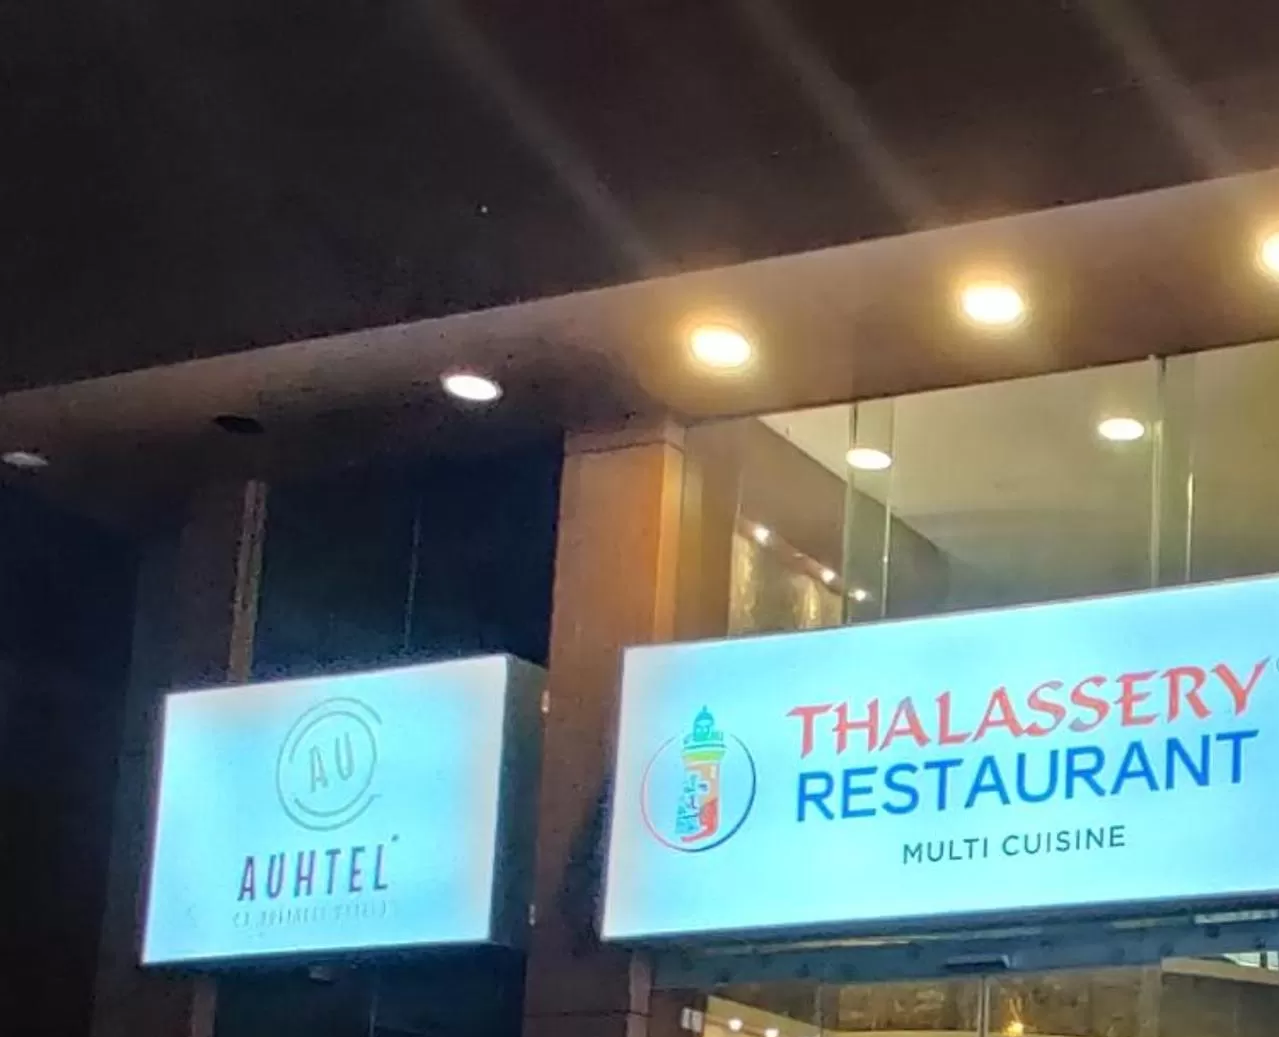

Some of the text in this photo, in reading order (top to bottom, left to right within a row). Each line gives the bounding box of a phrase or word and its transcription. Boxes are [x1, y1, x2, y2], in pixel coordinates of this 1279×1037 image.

[786, 655, 1271, 759] THALASSERY
[308, 730, 356, 794] AU
[796, 729, 1260, 824] RESTAURANT
[237, 843, 388, 901] AUHTEL
[902, 825, 1127, 865] MULTI CUISINE
